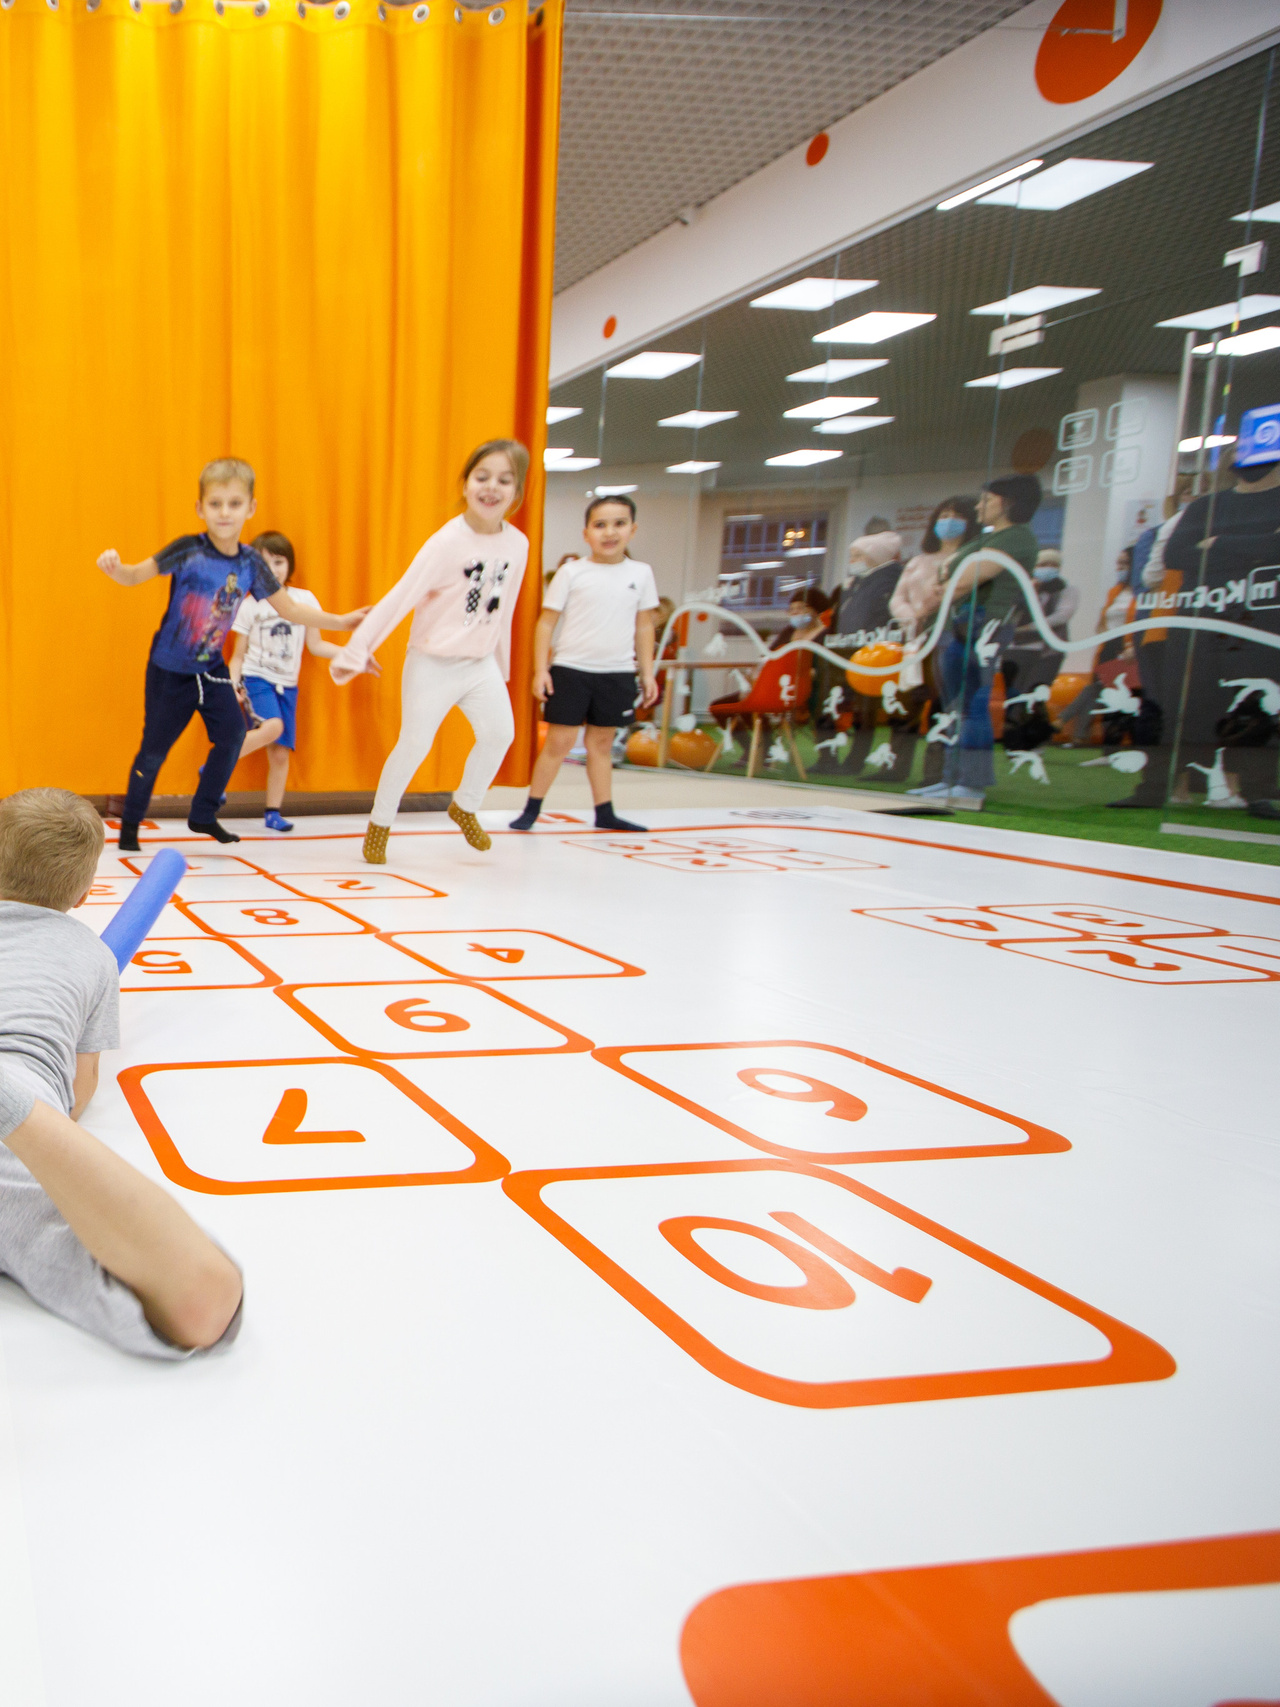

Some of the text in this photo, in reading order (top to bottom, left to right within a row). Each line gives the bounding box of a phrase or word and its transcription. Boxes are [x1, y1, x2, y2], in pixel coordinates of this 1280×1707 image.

[325, 879, 377, 891] 2
[239, 907, 301, 926] 8
[925, 915, 999, 932] 4
[1052, 911, 1145, 927] 3
[131, 950, 194, 975] 5
[467, 943, 526, 965] 4
[1066, 950, 1182, 971] 2
[261, 1088, 367, 1146] 7
[657, 1211, 934, 1311] 10
